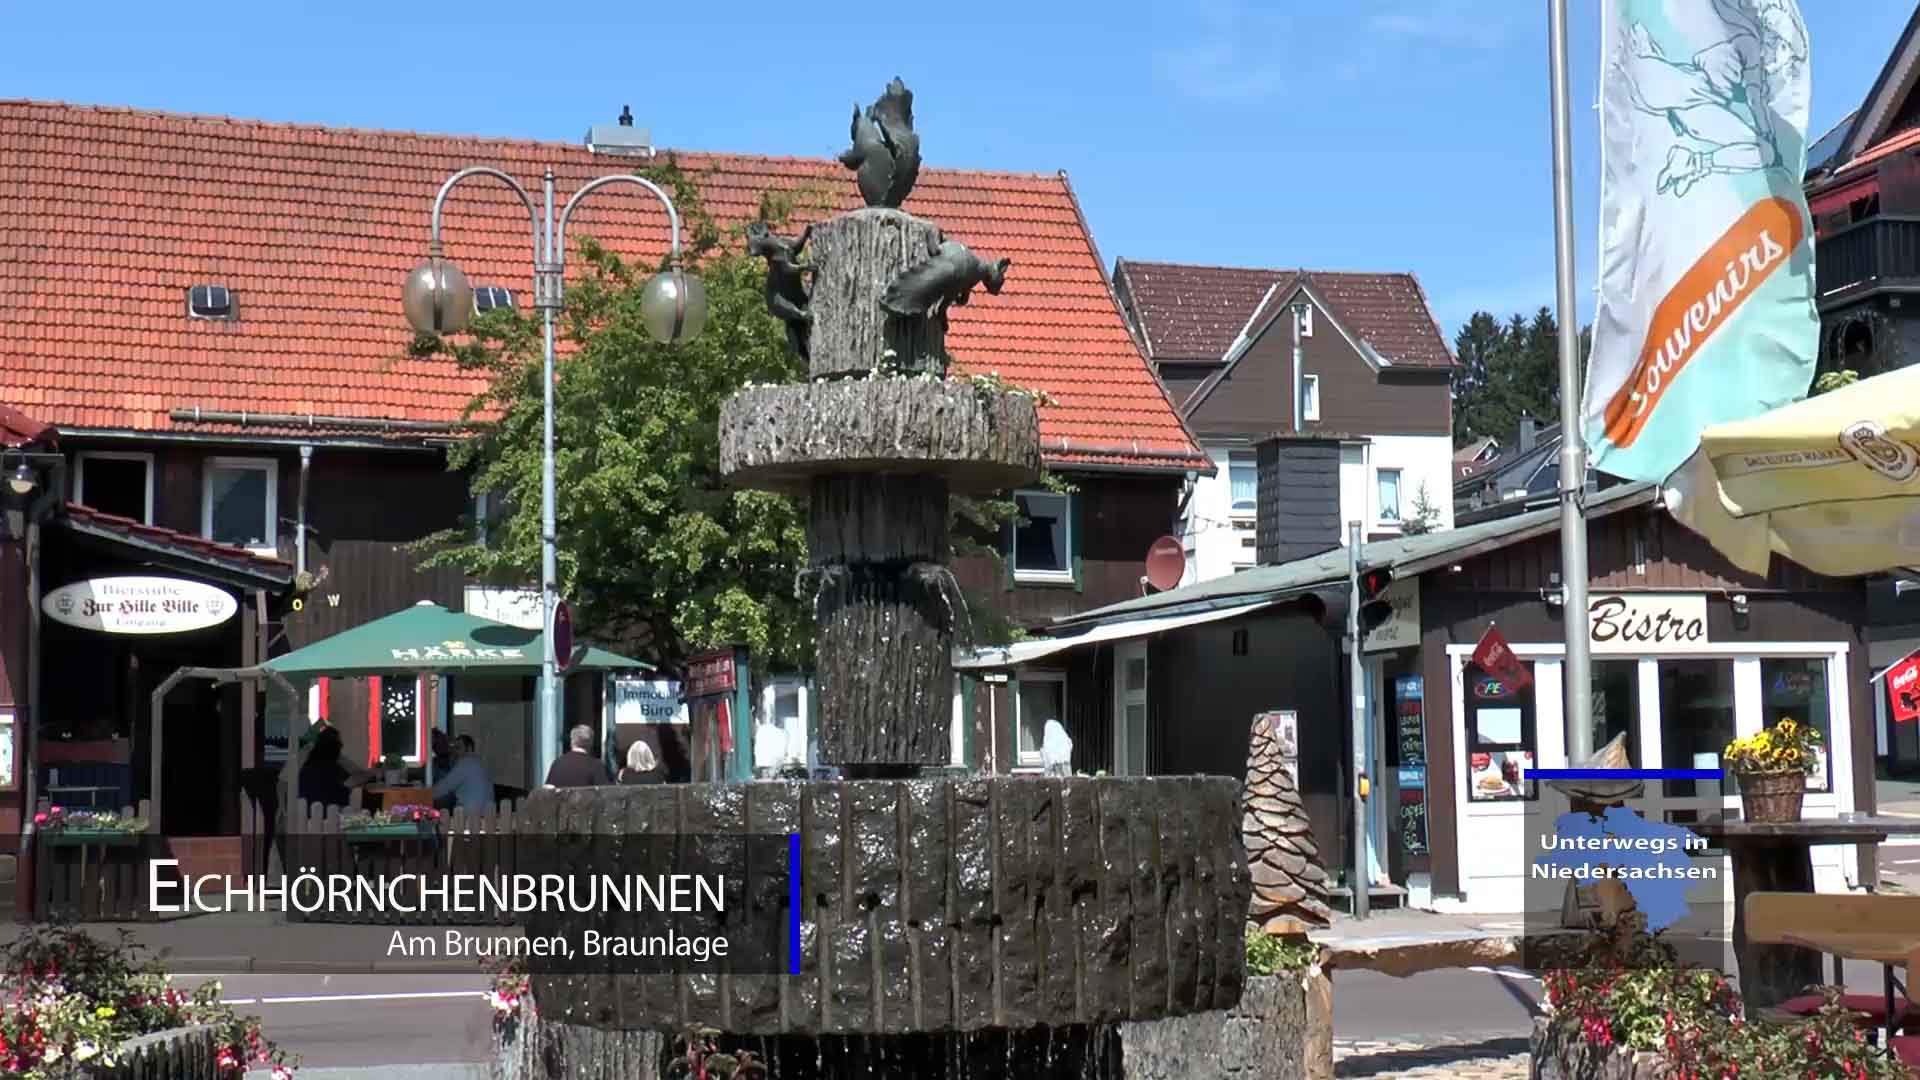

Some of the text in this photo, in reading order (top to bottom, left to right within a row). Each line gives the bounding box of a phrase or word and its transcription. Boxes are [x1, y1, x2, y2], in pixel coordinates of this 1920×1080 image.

[82, 598, 113, 617] Zur
[118, 598, 157, 615] Hille
[1588, 596, 1705, 643] Bistro
[640, 702, 673, 717] Büro
